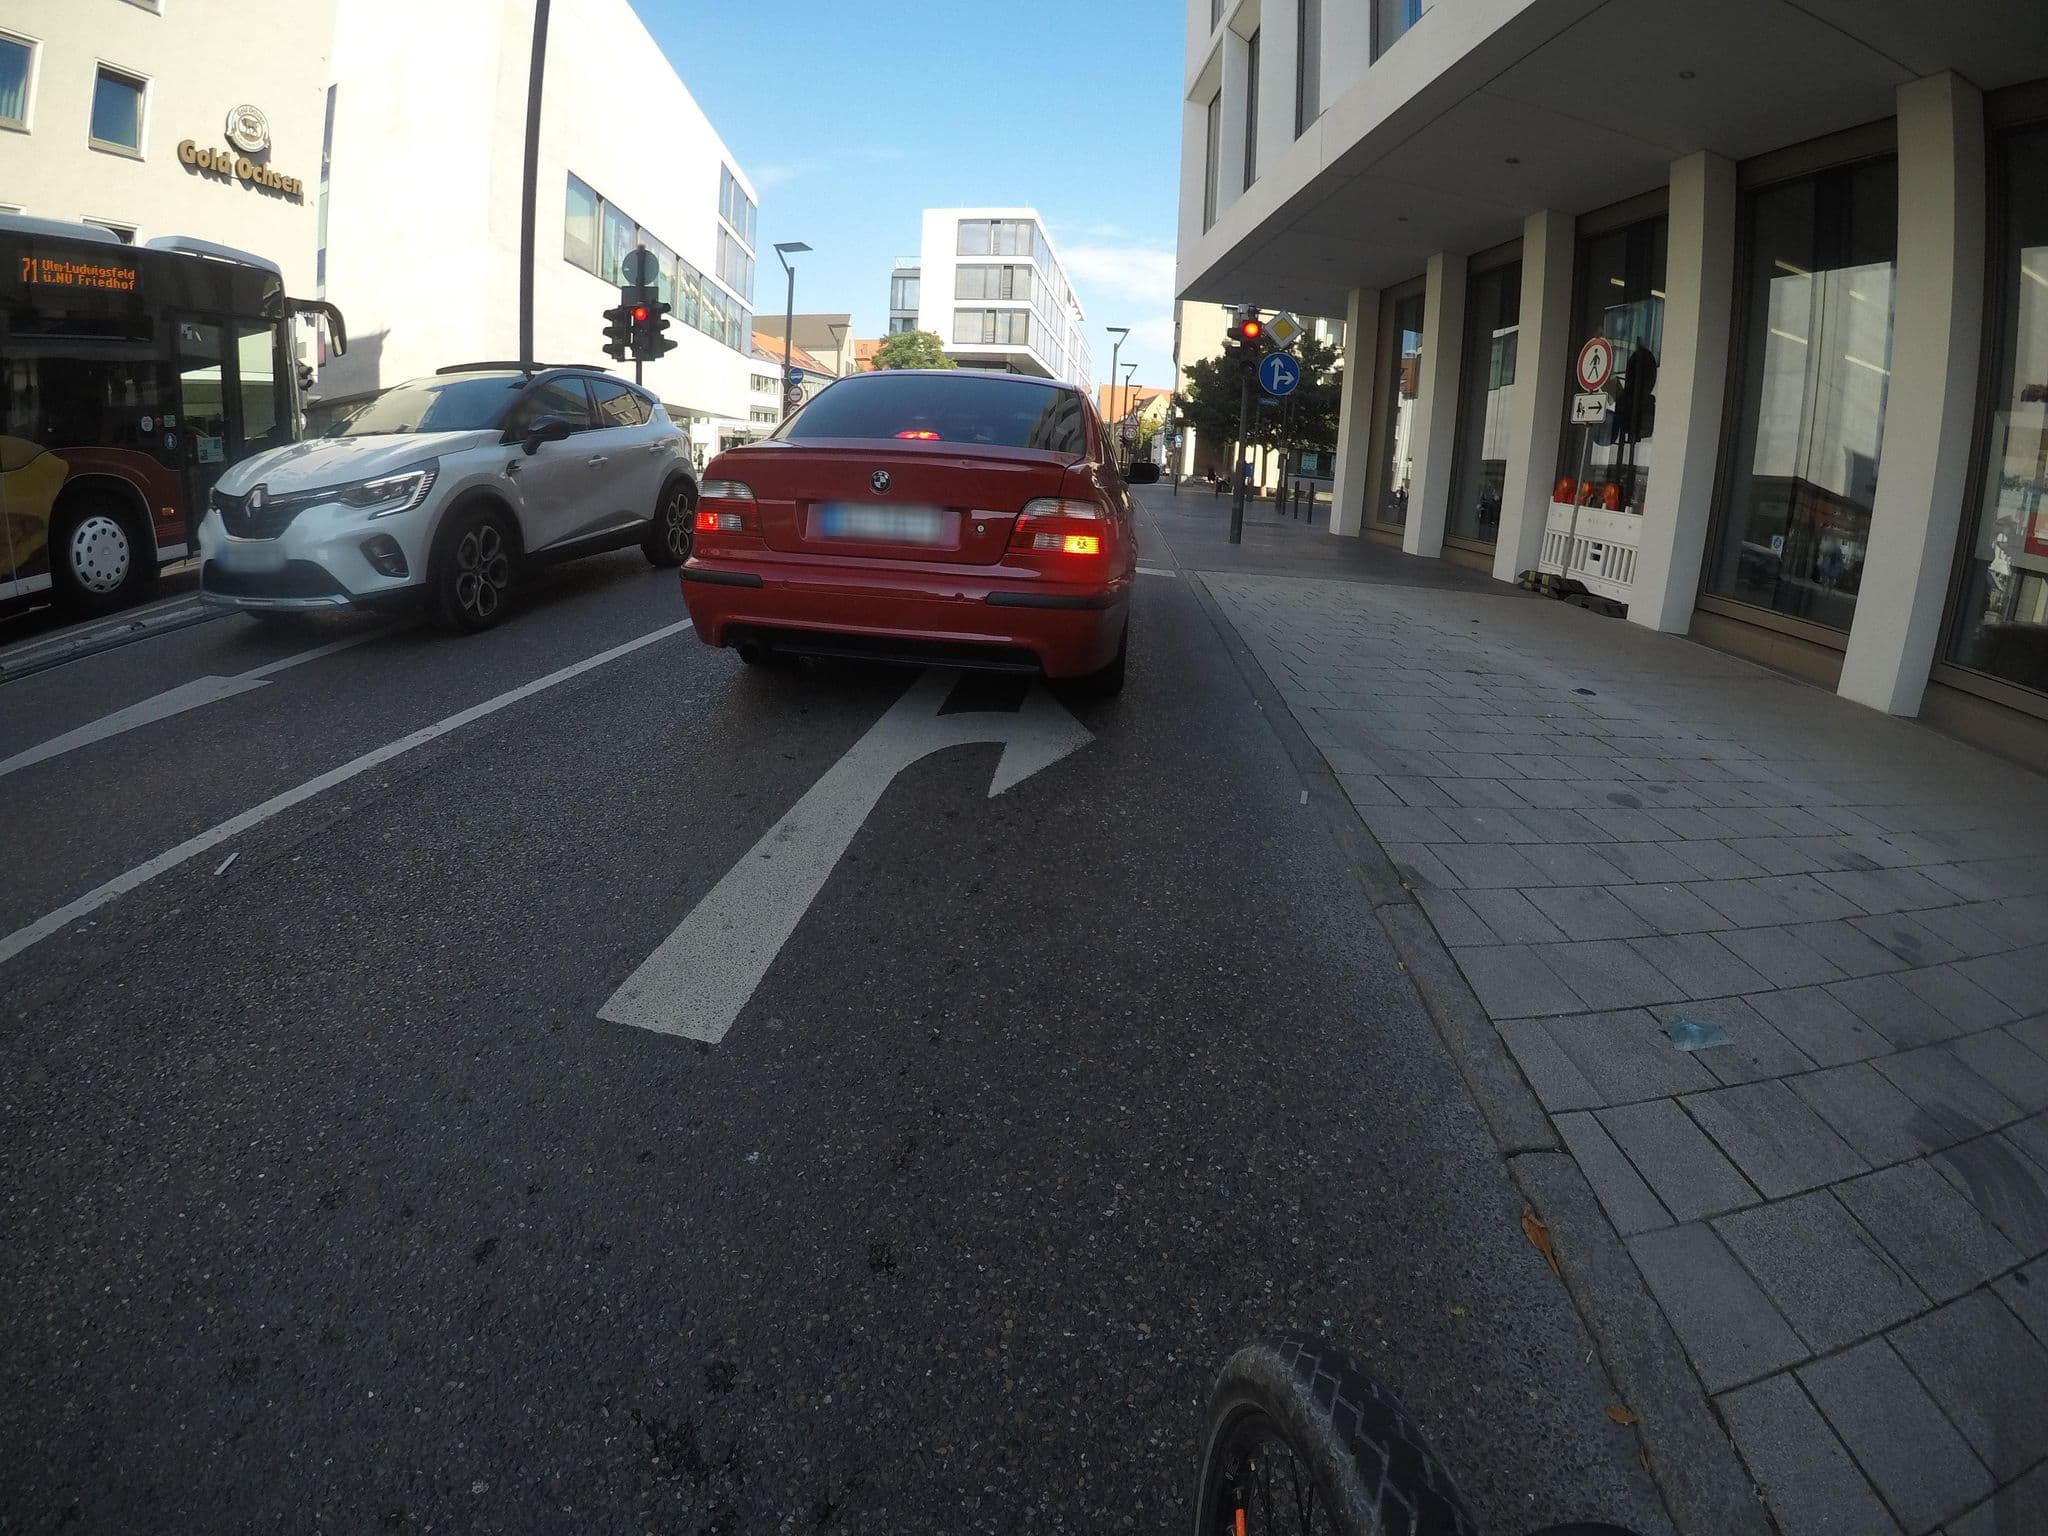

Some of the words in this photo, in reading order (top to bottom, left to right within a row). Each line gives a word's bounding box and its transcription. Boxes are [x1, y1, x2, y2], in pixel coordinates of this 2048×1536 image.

[177, 139, 231, 174] Gold
[235, 157, 303, 195] Ochsen
[22, 257, 38, 282] 71
[78, 274, 135, 289] Friedhof
